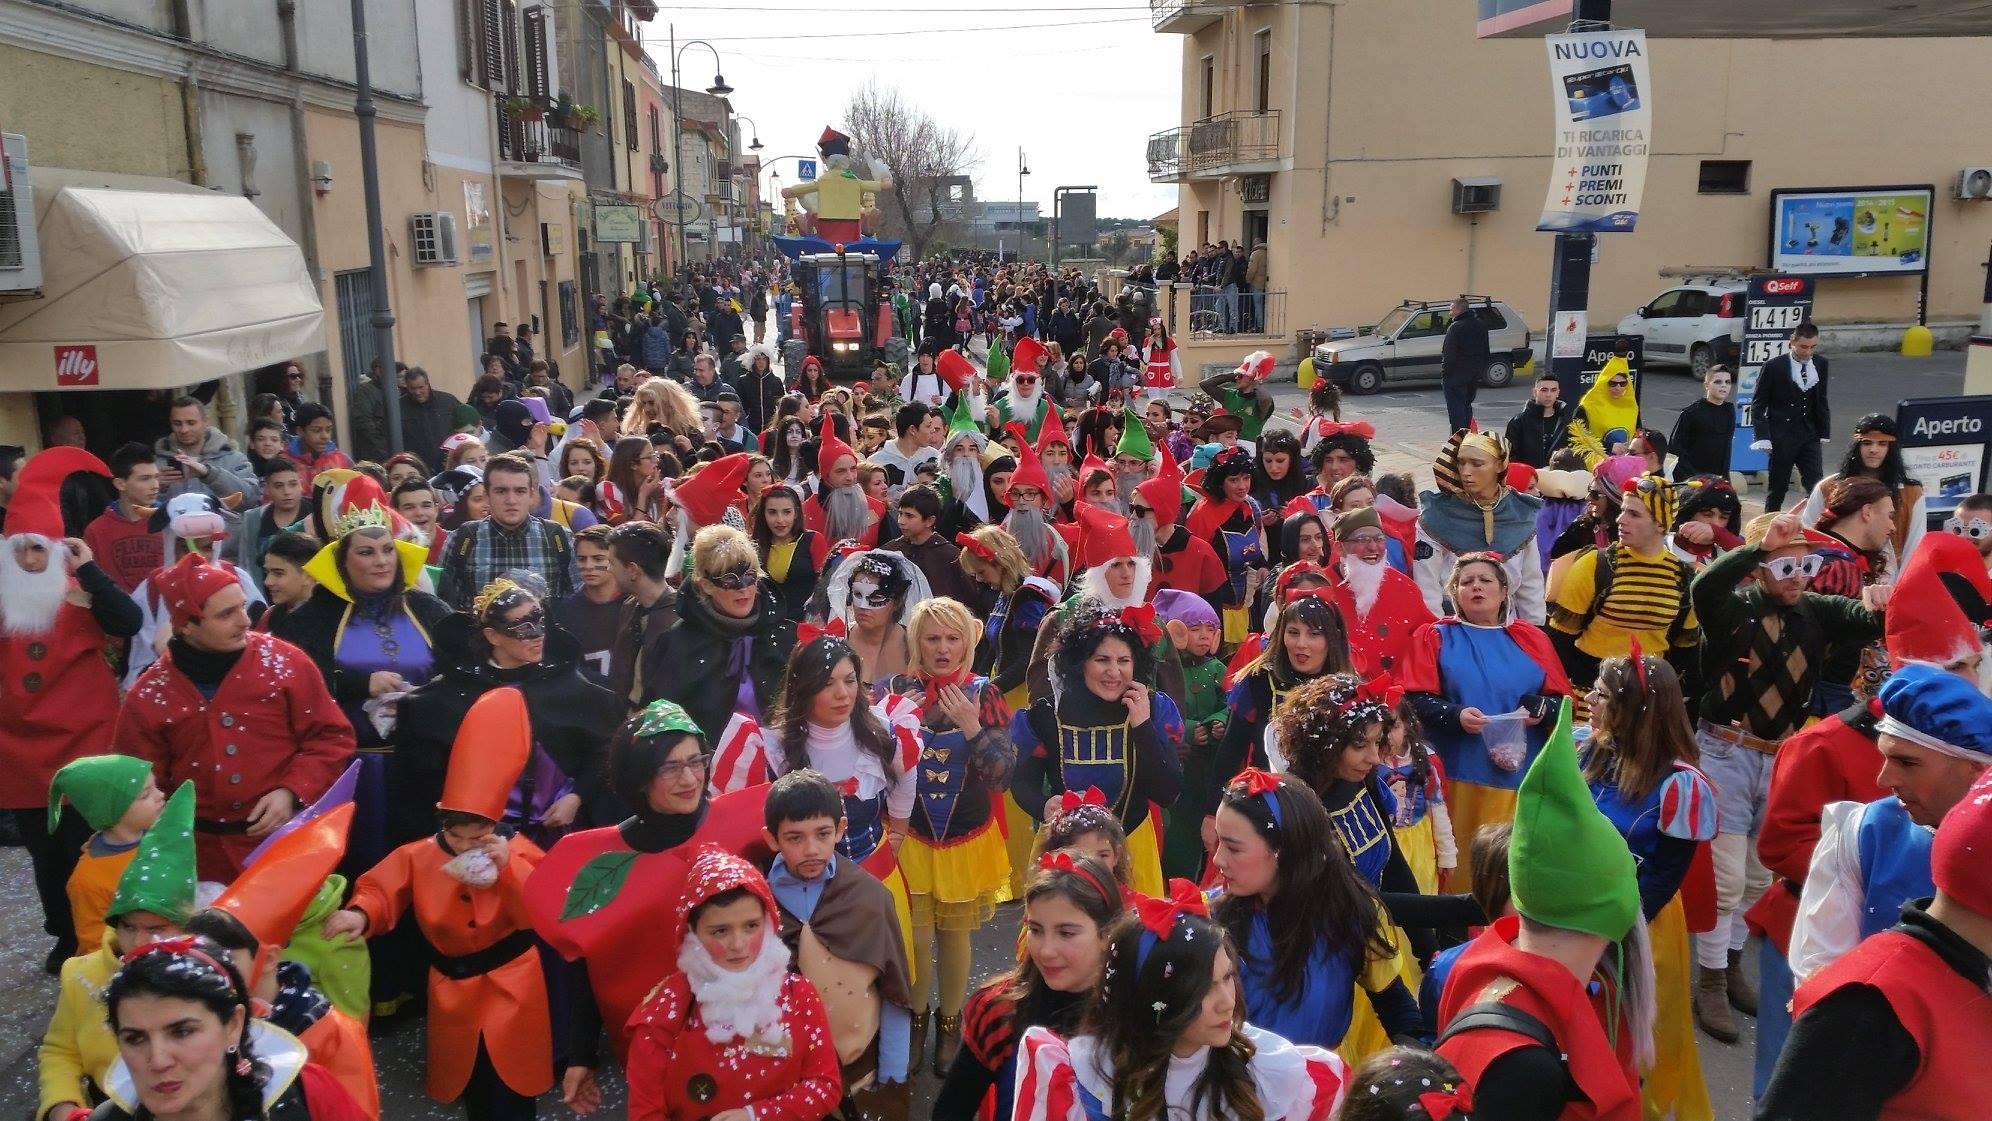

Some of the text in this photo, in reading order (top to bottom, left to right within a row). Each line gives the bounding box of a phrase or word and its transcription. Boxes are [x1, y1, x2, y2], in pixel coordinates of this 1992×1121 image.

[1554, 40, 1641, 60] NUOVA
[1563, 129, 1643, 143] TI RICARICA
[1558, 144, 1647, 158] DI VANTAGGI
[1581, 164, 1622, 177] PUNTI
[1578, 179, 1623, 191] PREMI
[1575, 194, 1627, 206] SCONTI
[1754, 307, 1800, 328] 1,419
[1587, 350, 1635, 365] Apeo
[58, 350, 95, 381] illy
[1913, 415, 1982, 440] Aperto
